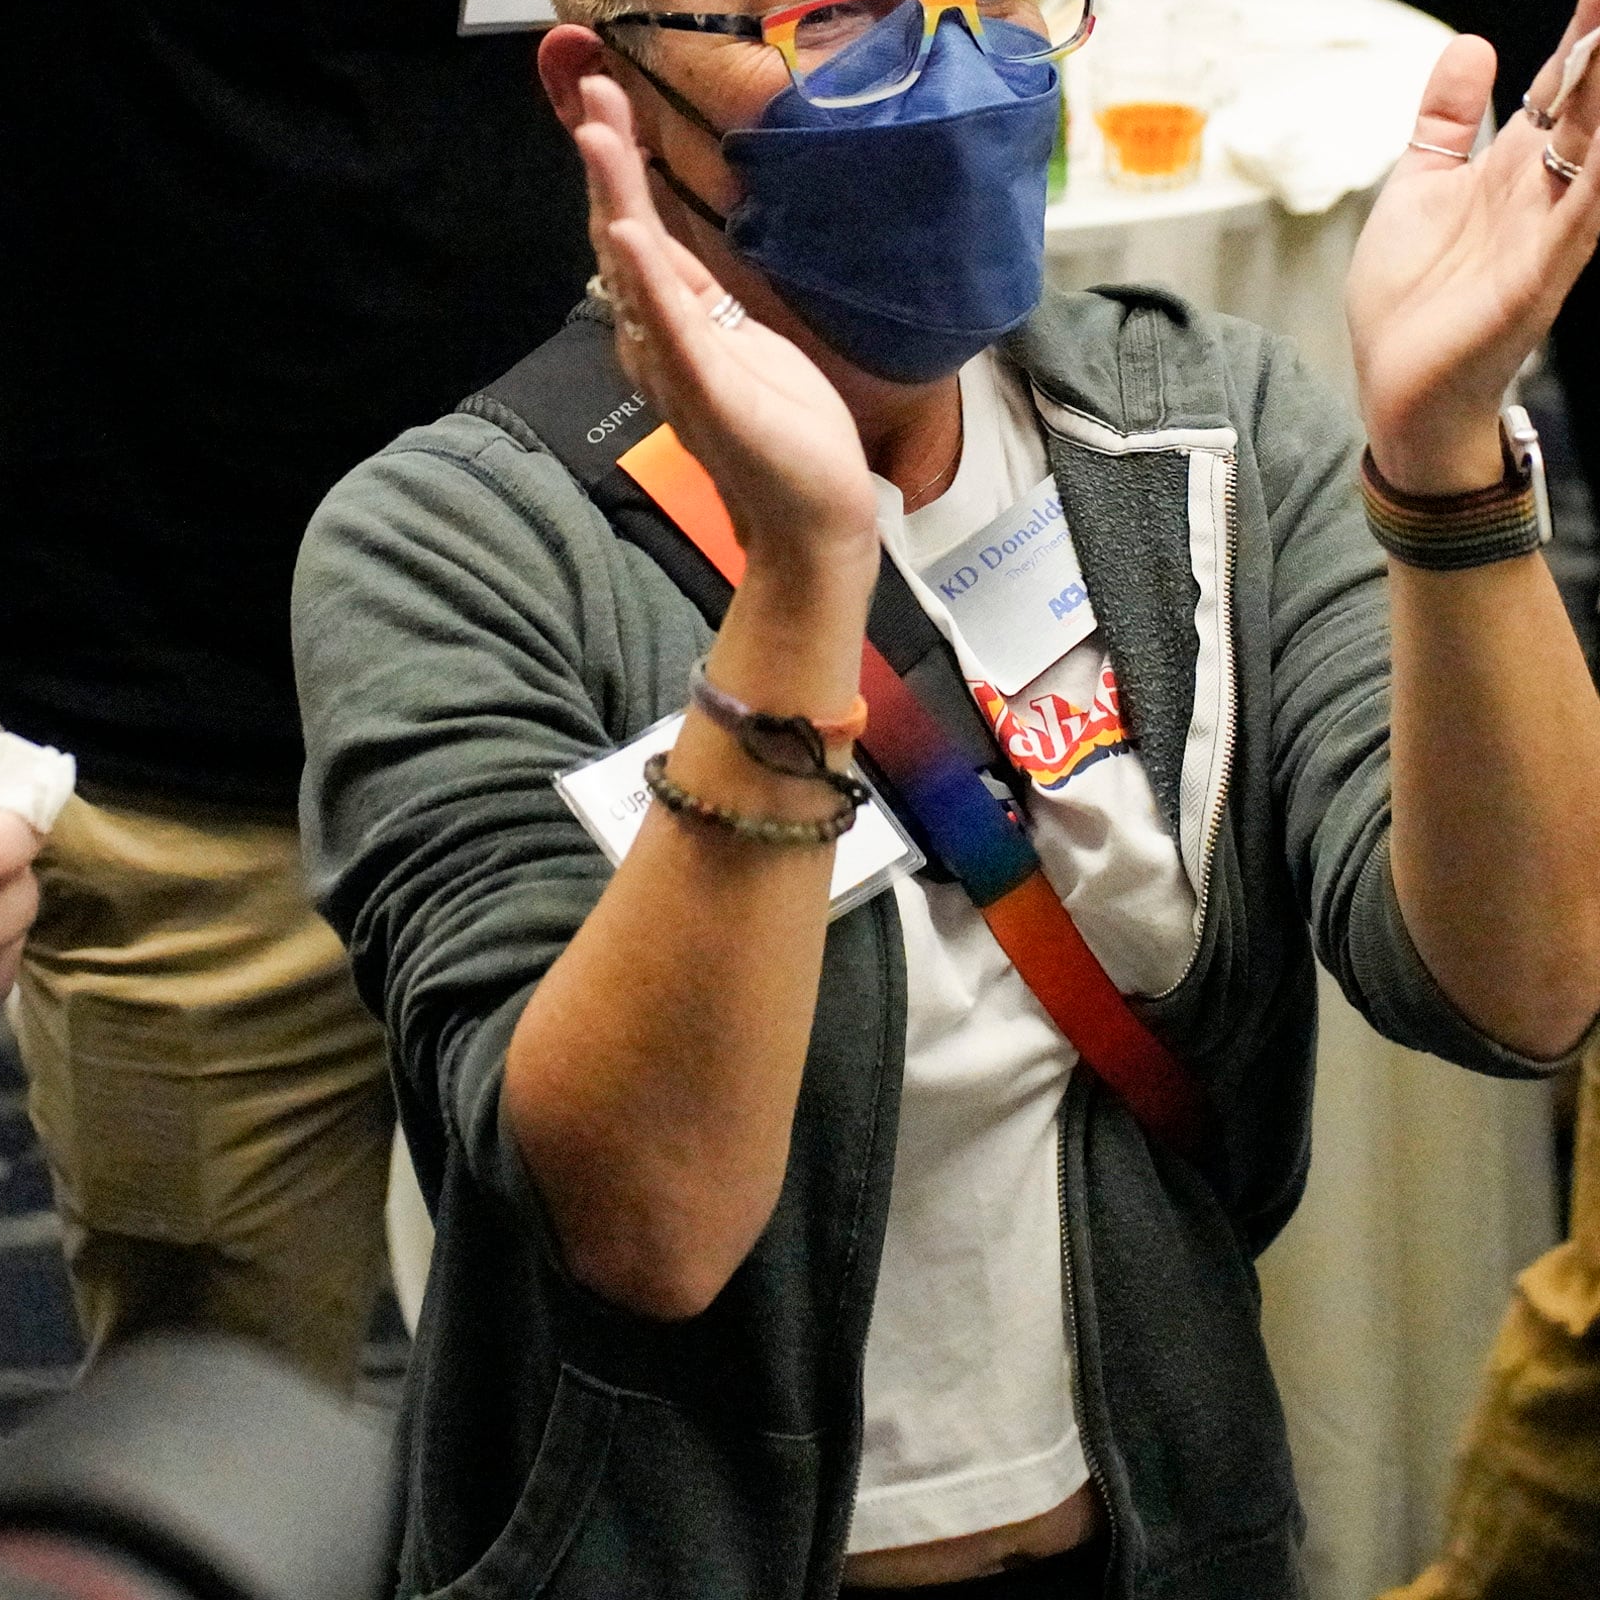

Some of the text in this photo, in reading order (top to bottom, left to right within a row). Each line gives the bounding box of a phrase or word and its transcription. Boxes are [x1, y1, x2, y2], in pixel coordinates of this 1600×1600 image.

[587, 390, 648, 444] OSPRE
[939, 496, 1065, 601] KD Donald
